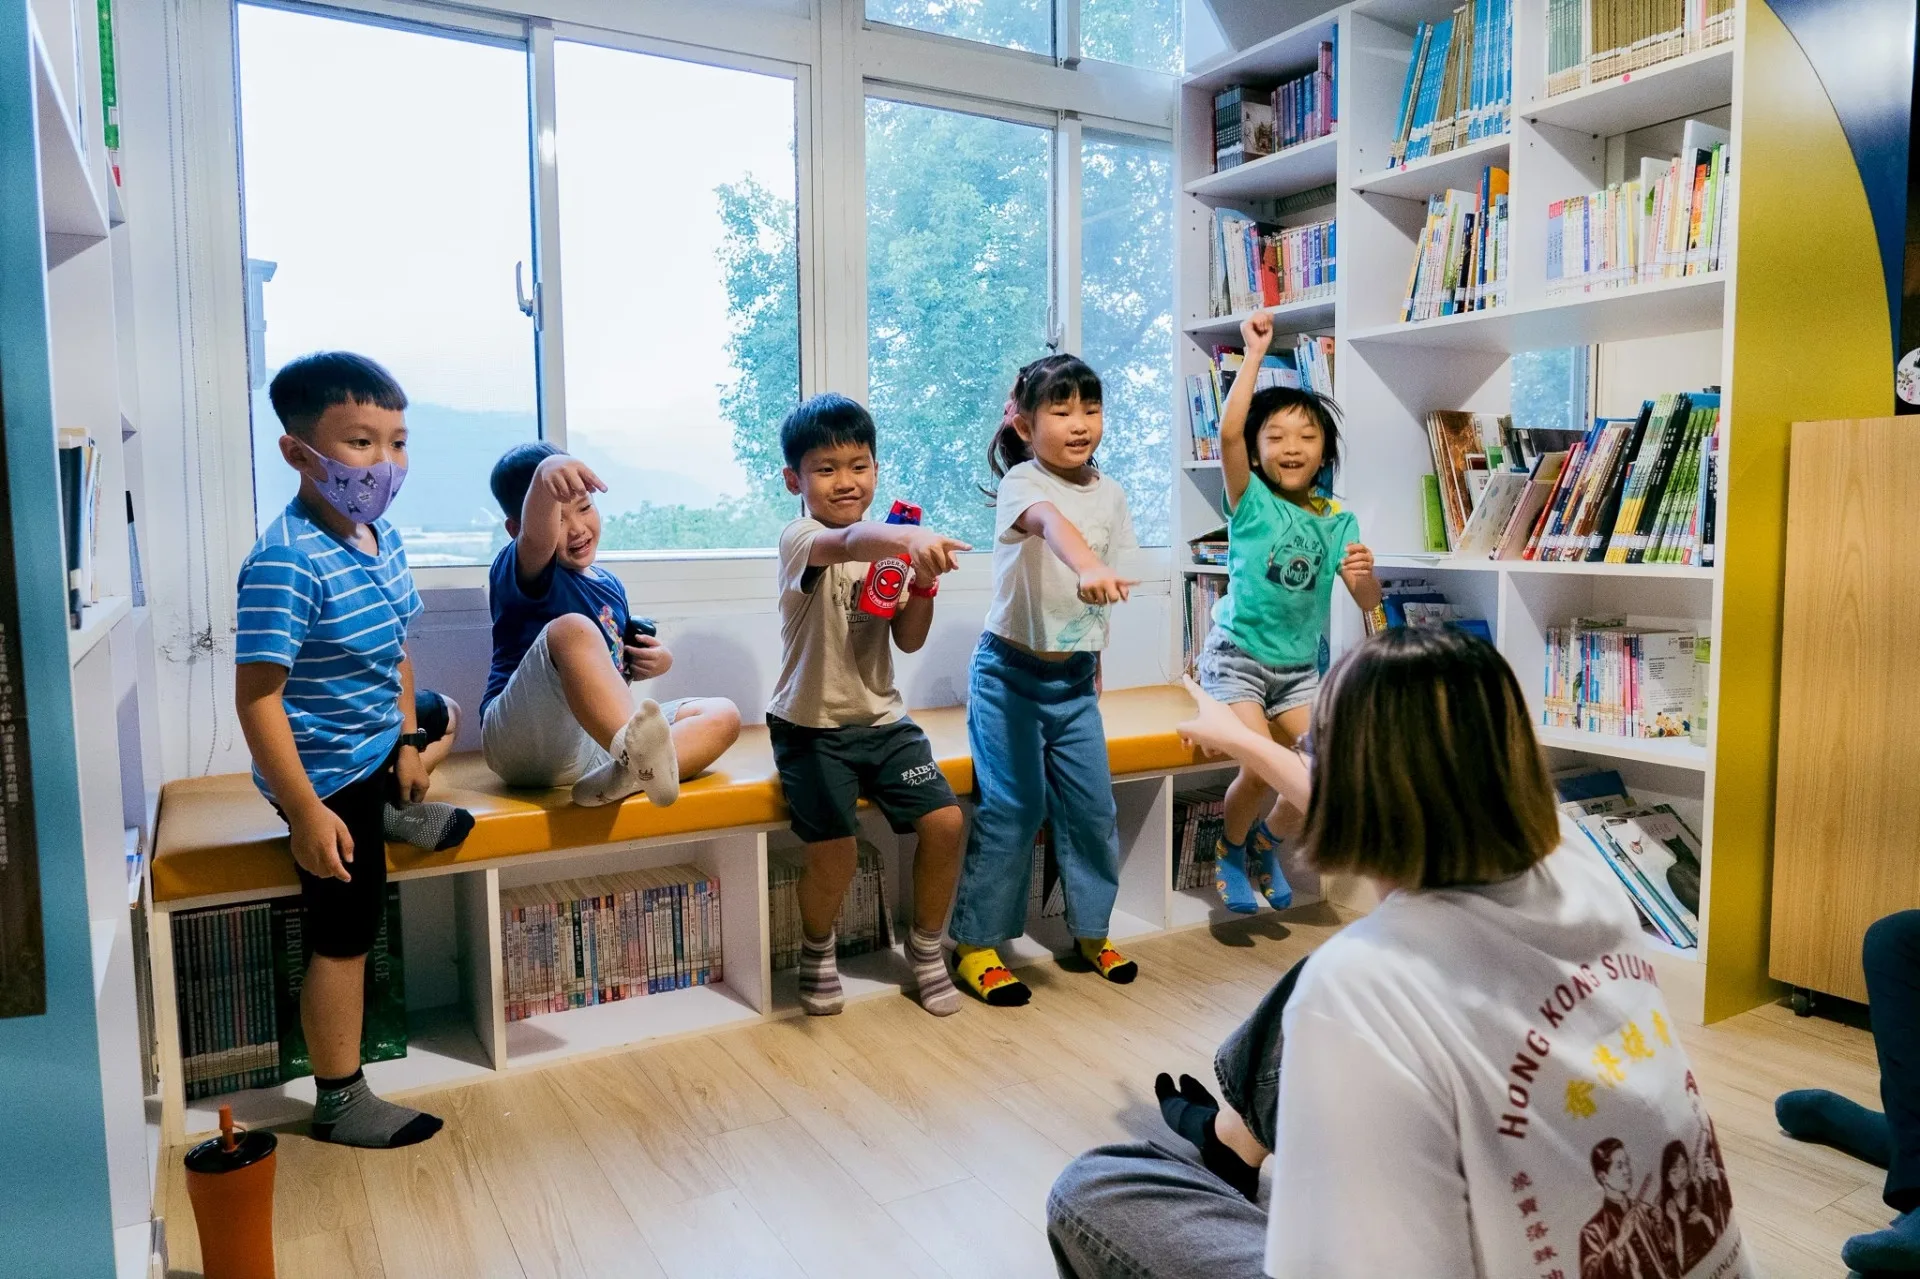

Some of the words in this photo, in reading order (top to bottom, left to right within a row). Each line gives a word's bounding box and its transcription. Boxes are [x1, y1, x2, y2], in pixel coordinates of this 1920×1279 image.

[901, 761, 936, 781] FAIRY
[285, 916, 304, 997] HERITAGE
[1498, 1029, 1550, 1139] HONG
[1539, 963, 1601, 1029] KONG
